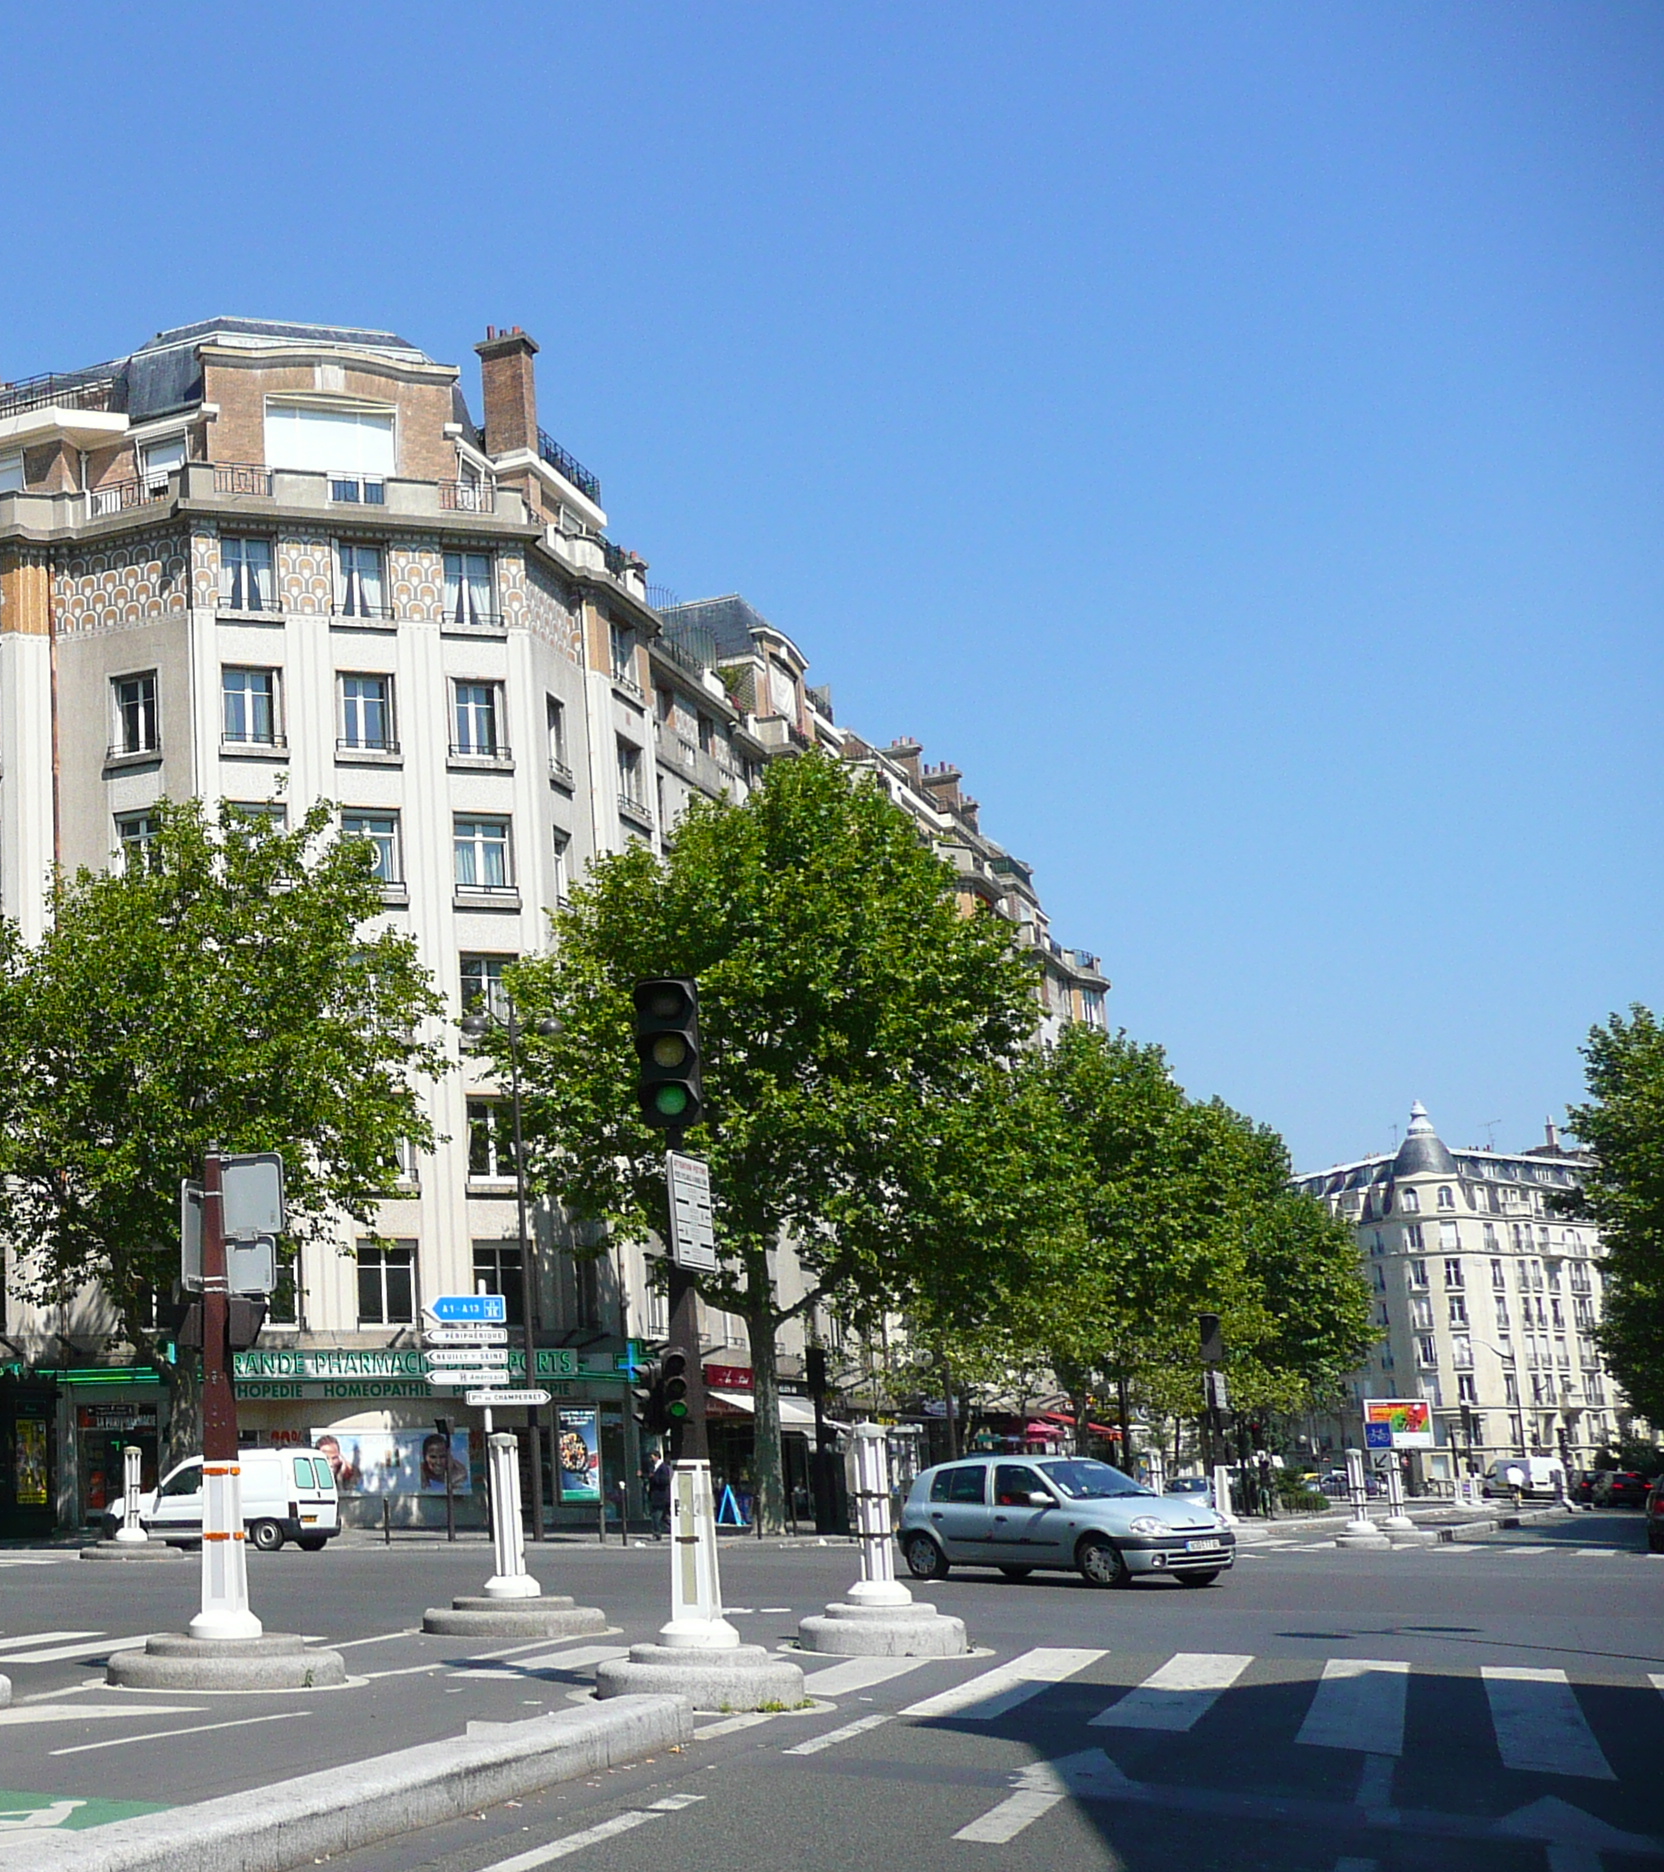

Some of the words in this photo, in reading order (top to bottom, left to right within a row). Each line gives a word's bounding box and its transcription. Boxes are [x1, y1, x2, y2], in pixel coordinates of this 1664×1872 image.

[442, 1304, 454, 1313] A1
[461, 1304, 479, 1313] A13
[233, 1352, 305, 1374] RANDE
[237, 1384, 303, 1398] HOPEDIE
[324, 1384, 432, 1397] HOMEOPATHIE
